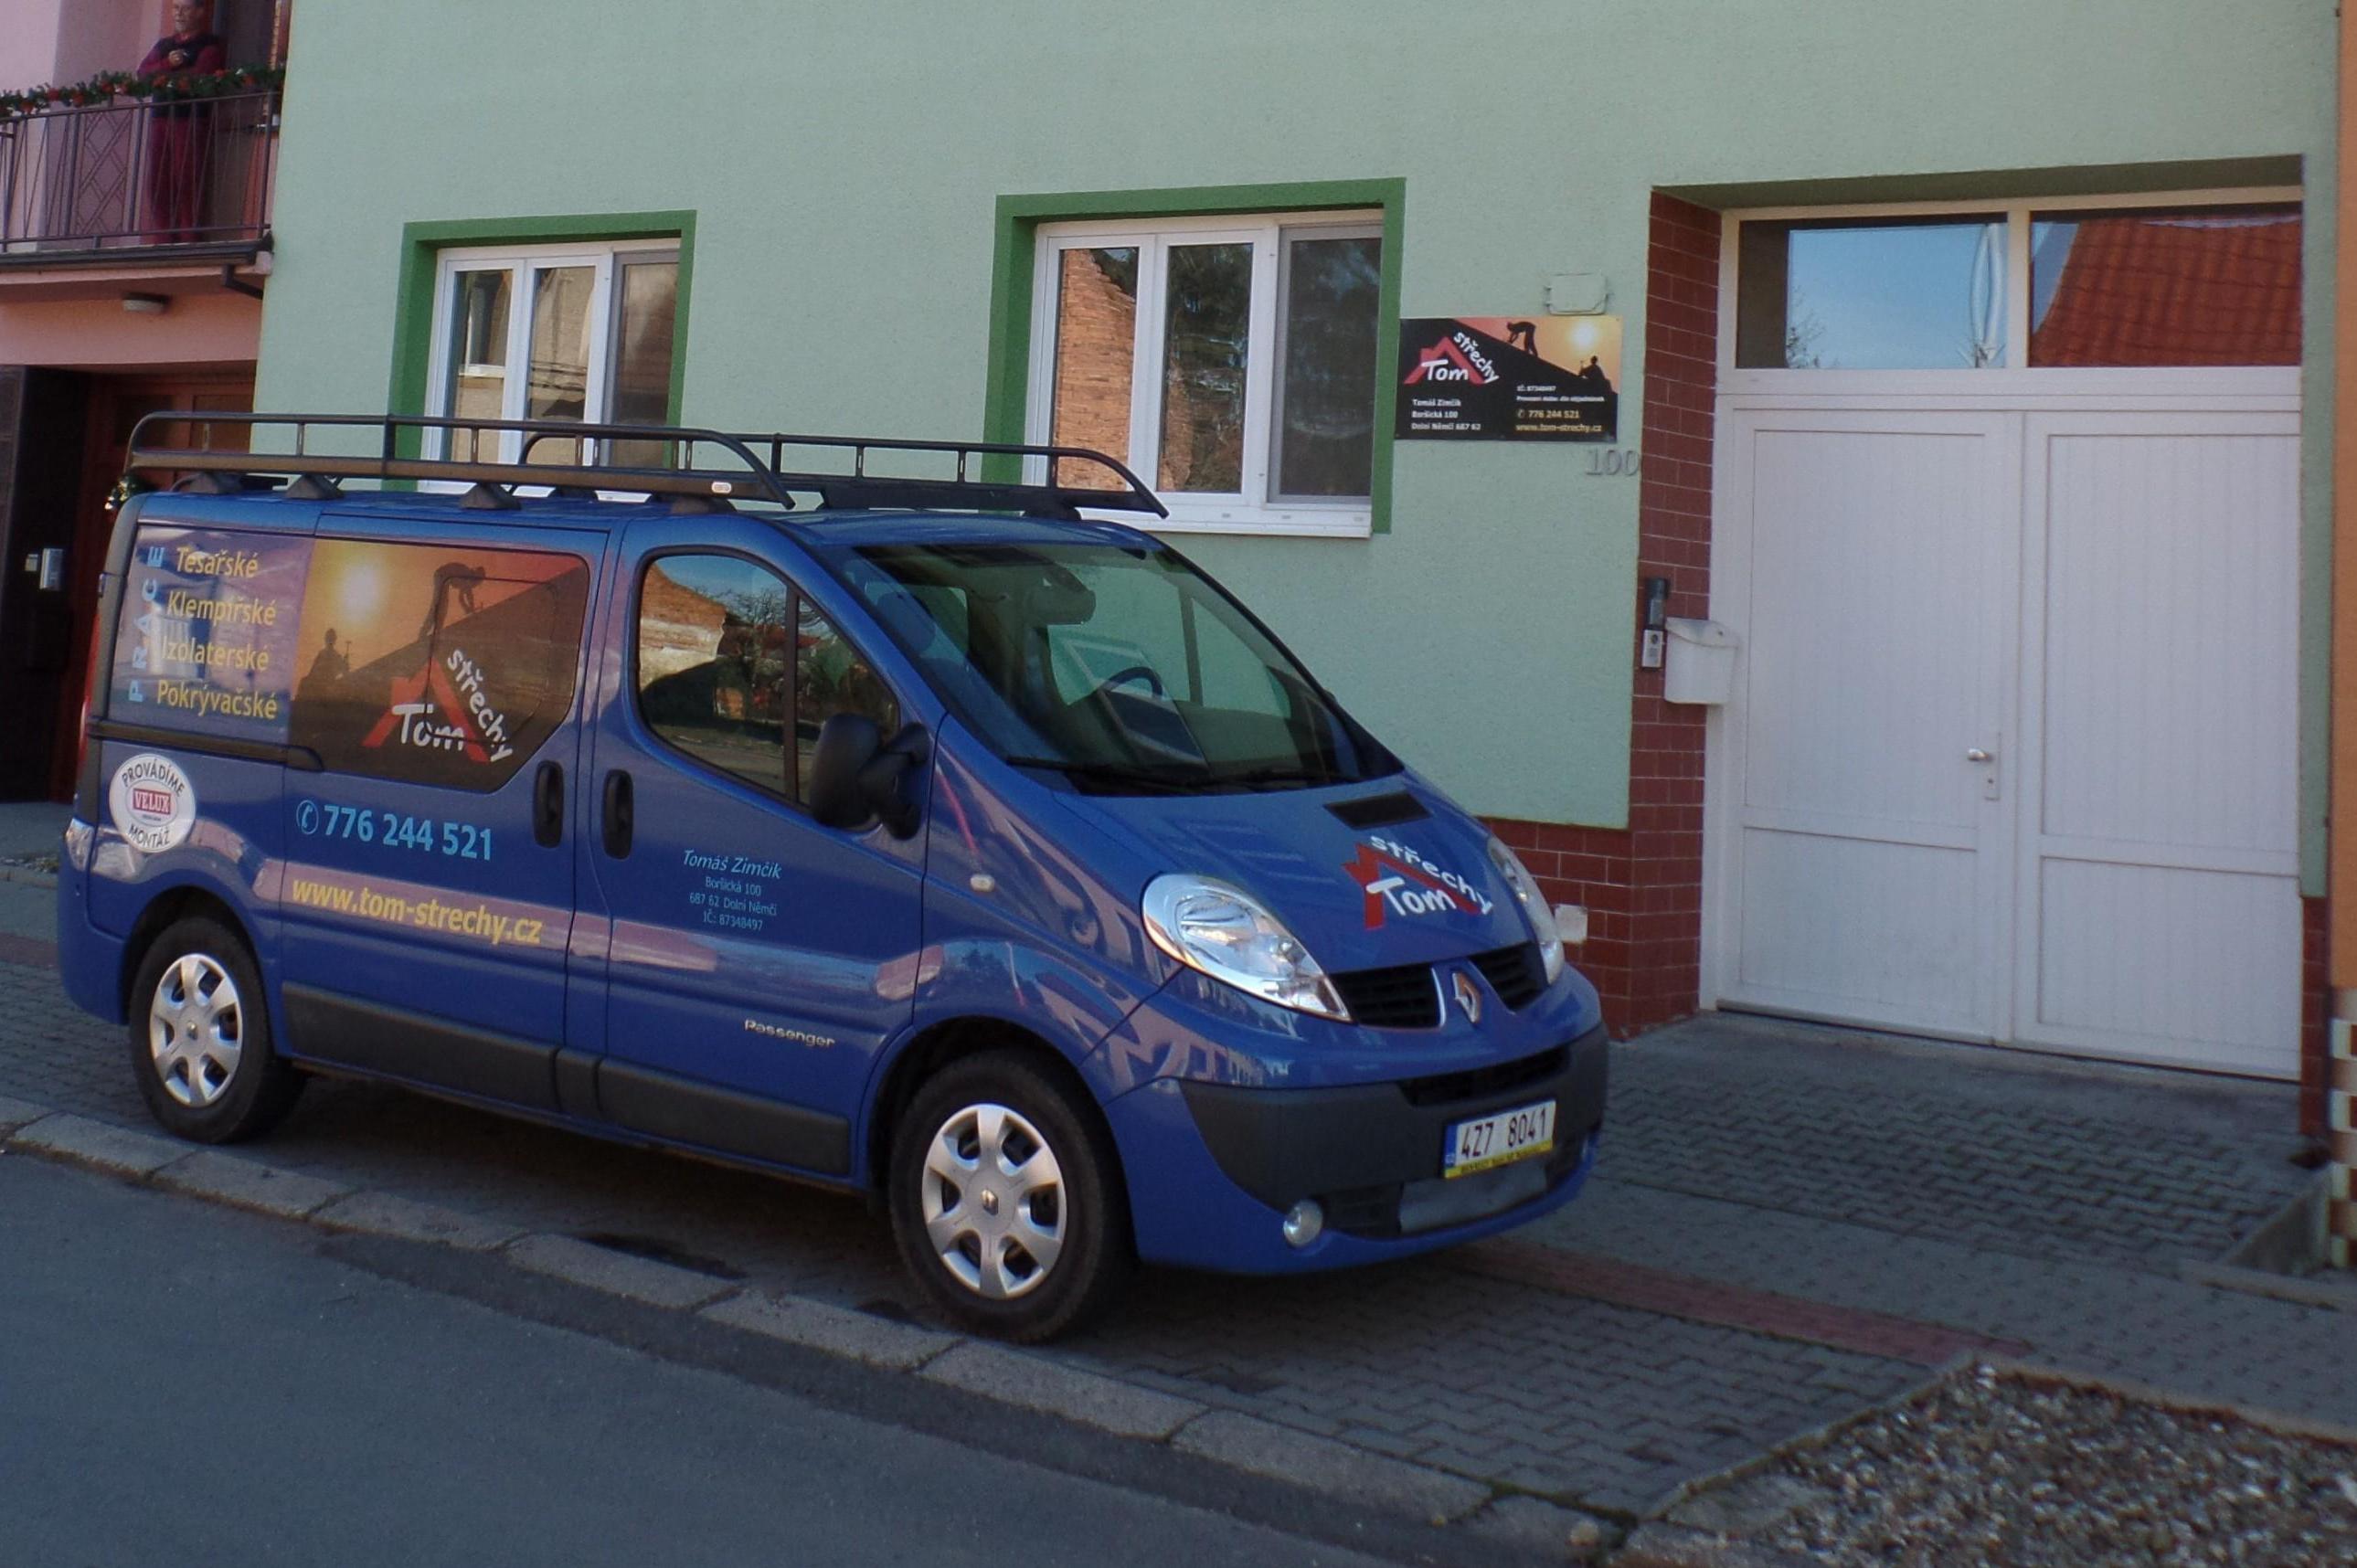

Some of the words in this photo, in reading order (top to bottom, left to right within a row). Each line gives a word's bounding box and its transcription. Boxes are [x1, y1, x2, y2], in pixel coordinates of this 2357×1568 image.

[1420, 359, 1470, 381] Tom
[1453, 331, 1500, 384] střechy
[1528, 409, 1545, 418] 776
[1545, 409, 1563, 418] 244
[1564, 409, 1580, 418] 521
[1586, 447, 1639, 476] 100
[176, 546, 259, 578] Tesařské
[161, 635, 270, 672] Izolaterské
[156, 678, 278, 719] Pokrývačské
[447, 650, 515, 763] střechy
[391, 704, 464, 751] Tom
[122, 758, 186, 797] PROVÁDÍME
[134, 790, 170, 813] VELUX
[129, 823, 171, 849] MONTÁŽ
[324, 804, 374, 842] 776
[383, 813, 434, 852] 244
[442, 822, 492, 861] 521
[683, 849, 729, 872] Tomáš
[689, 892, 706, 905] 687
[708, 895, 720, 907] 62
[744, 884, 761, 896] 100
[1365, 876, 1457, 916] Tom
[292, 878, 544, 945] www.tom-strechy.cz
[745, 1019, 836, 1048] Passenger
[1460, 1120, 1494, 1160] 4Z7
[1507, 1107, 1547, 1148] 8041
